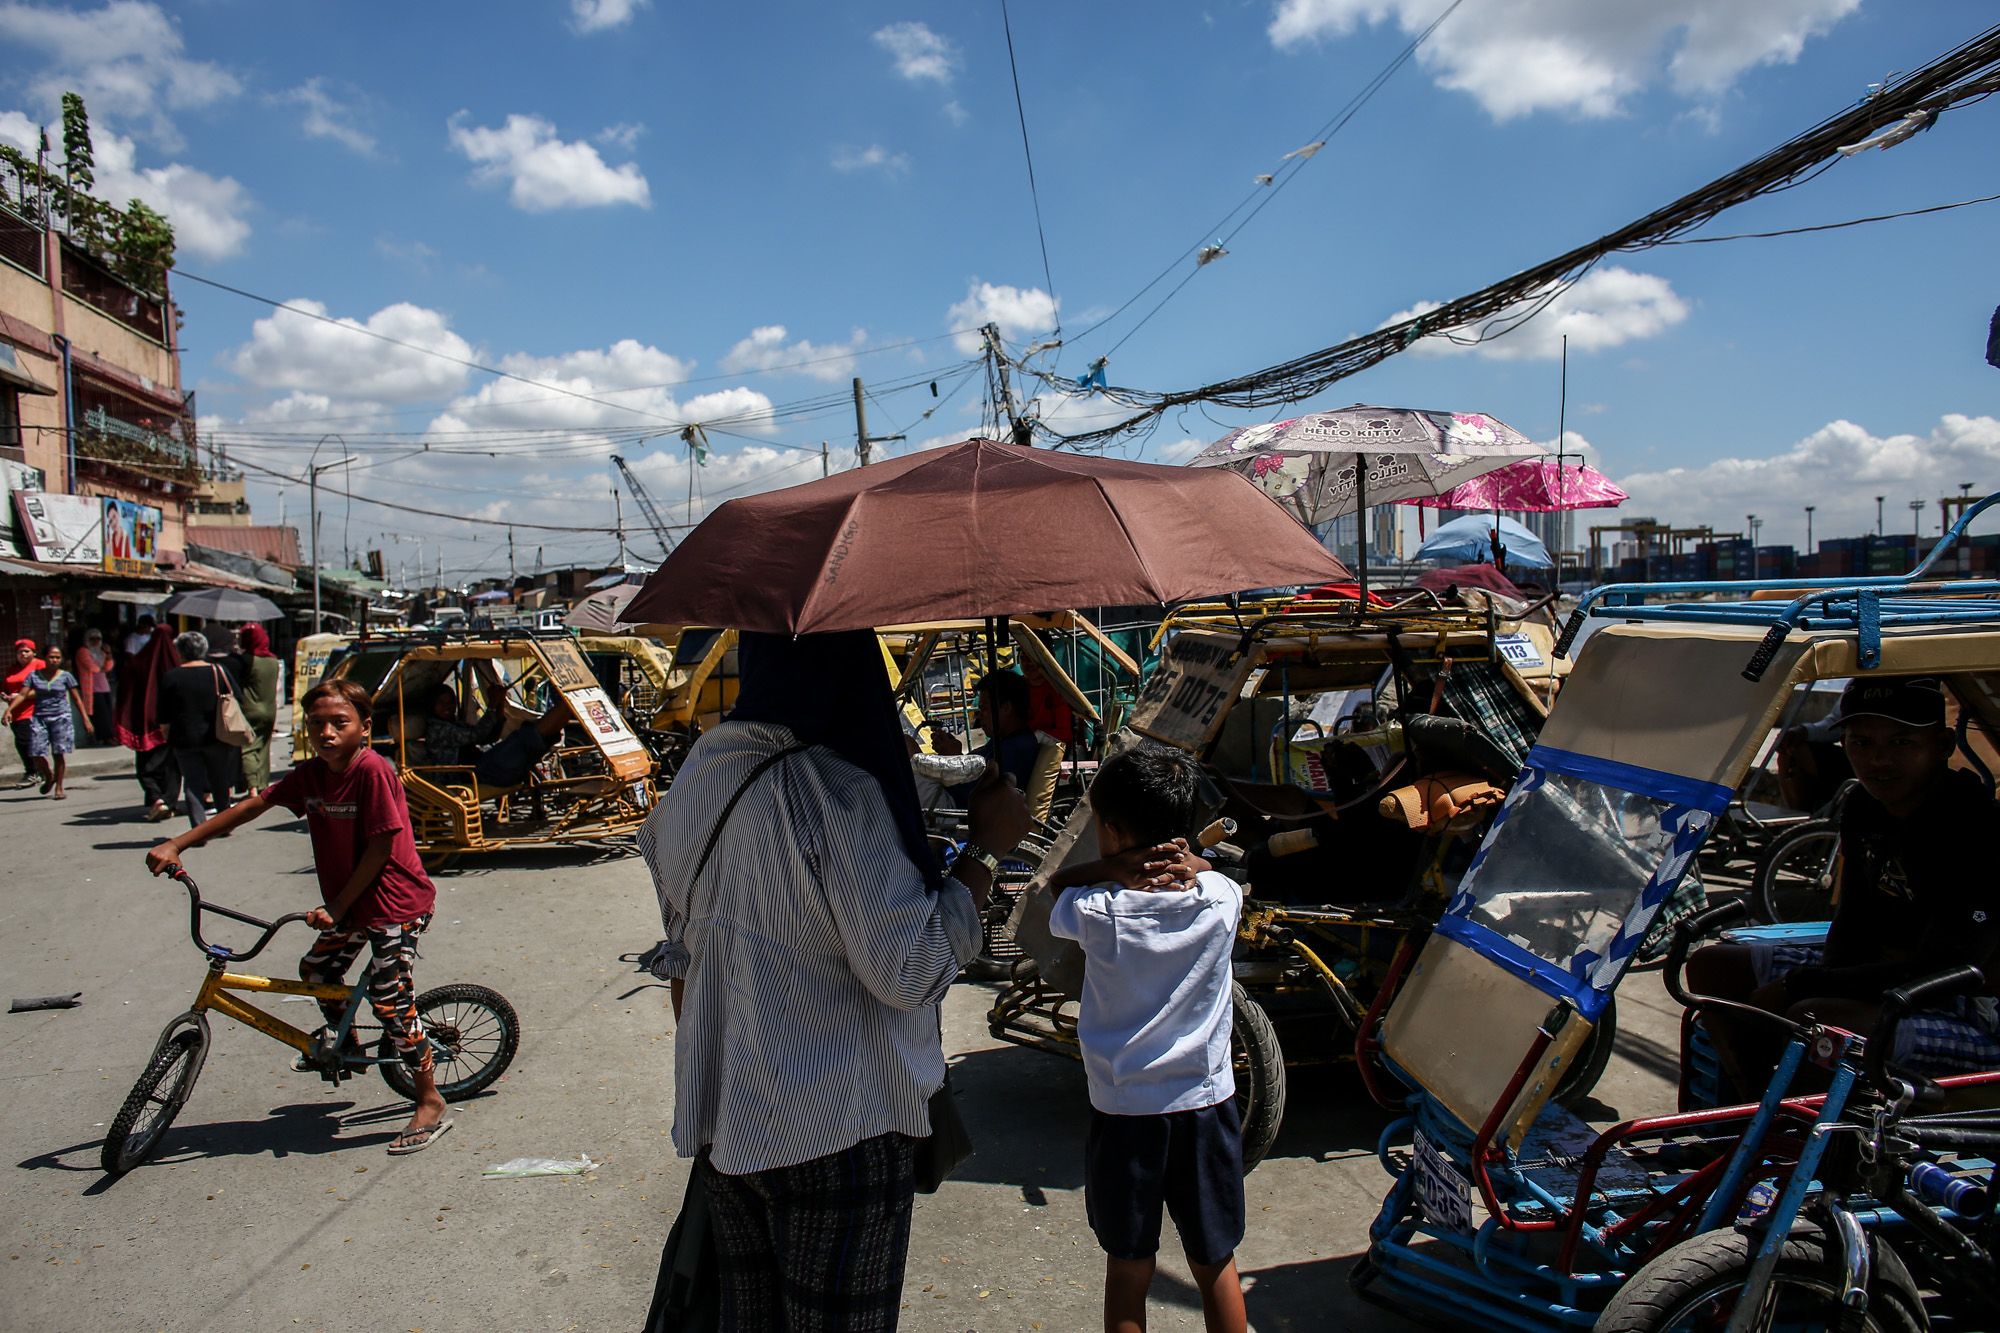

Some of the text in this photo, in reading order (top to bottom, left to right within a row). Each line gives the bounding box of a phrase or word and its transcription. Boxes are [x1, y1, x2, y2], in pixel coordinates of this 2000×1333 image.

[1303, 426, 1403, 438] HELLO KITTY
[1502, 644, 1528, 659] 113
